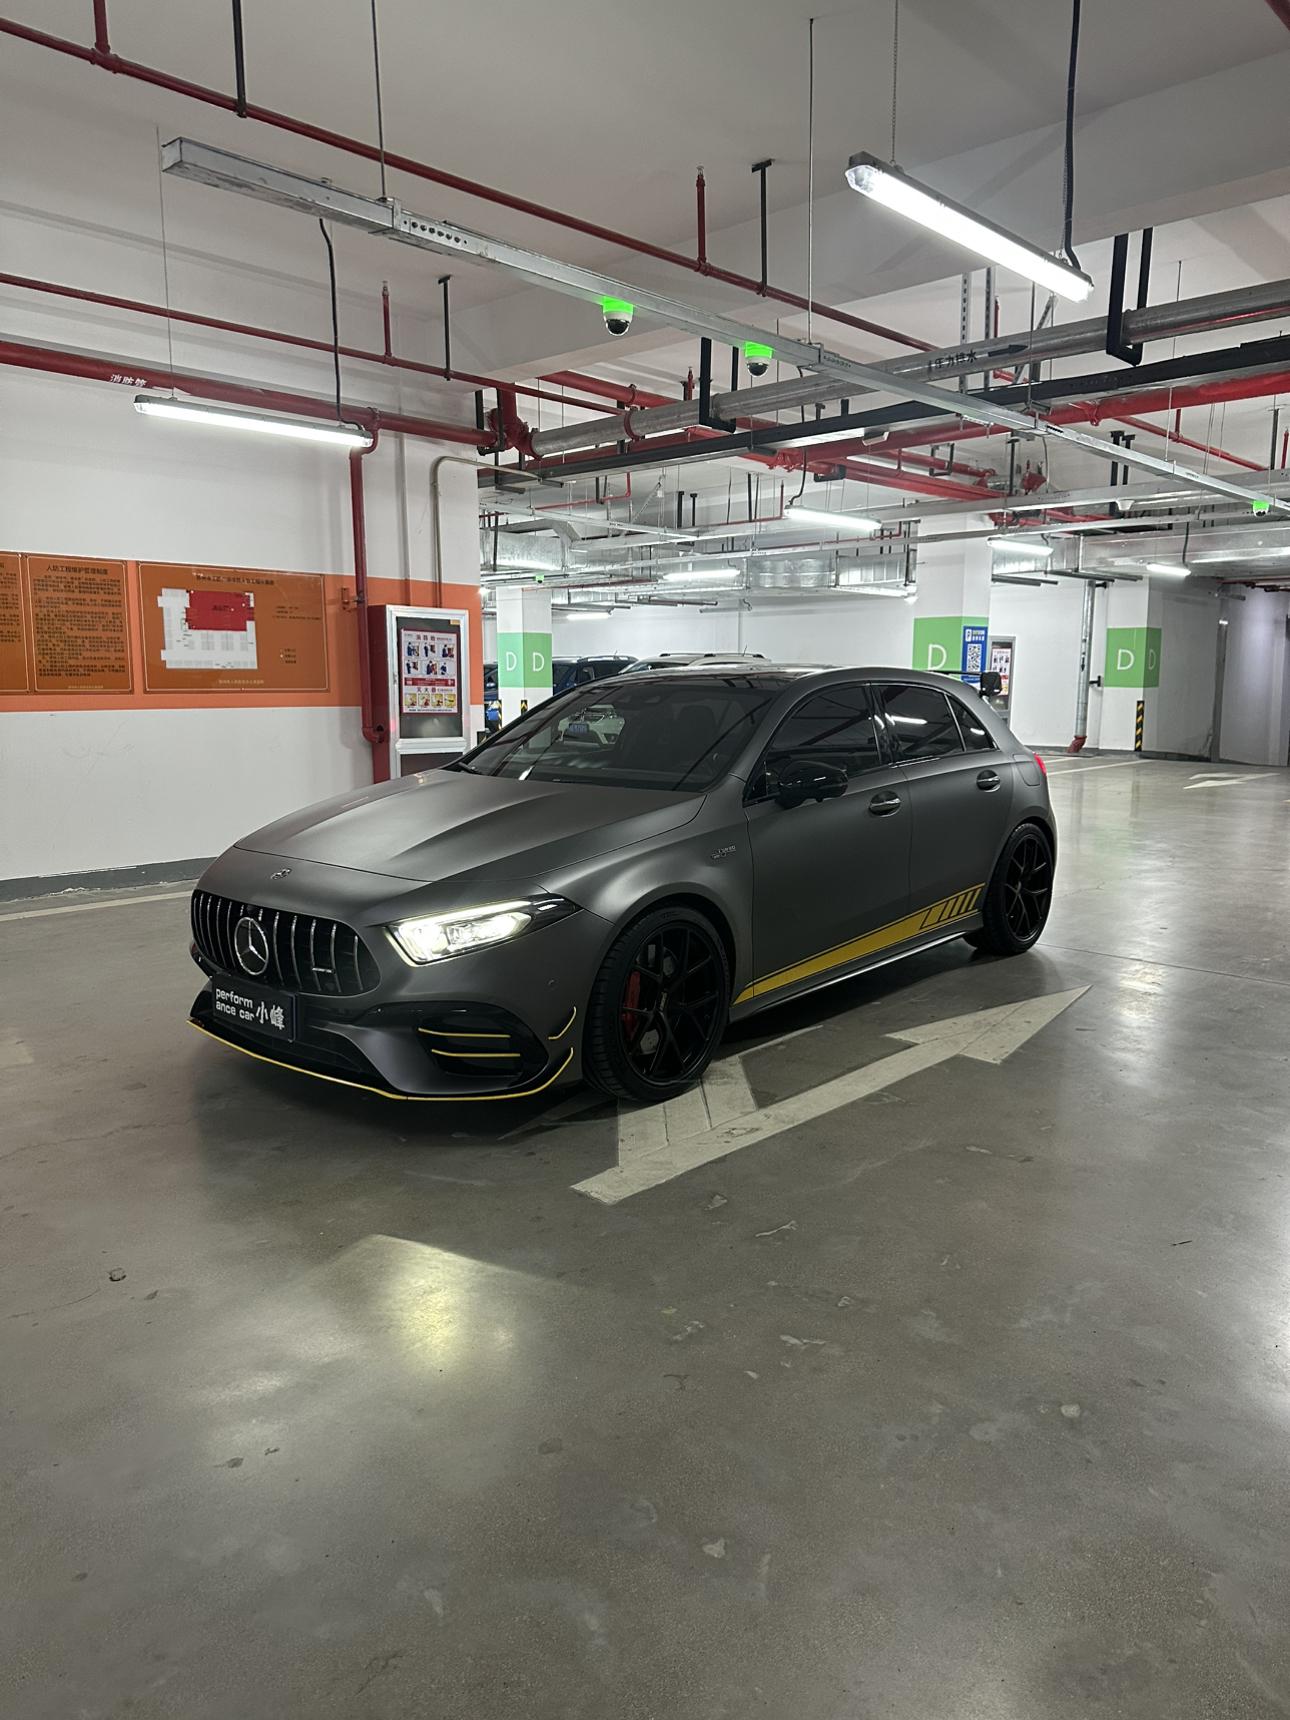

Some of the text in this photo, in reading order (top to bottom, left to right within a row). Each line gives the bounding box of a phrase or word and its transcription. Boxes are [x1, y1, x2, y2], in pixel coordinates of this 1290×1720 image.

[506, 651, 517, 671] D
[532, 651, 545, 671] D
[927, 644, 947, 670] D
[1117, 648, 1135, 670] D
[215, 988, 253, 1009] perform
[215, 1001, 255, 1022] ance car
